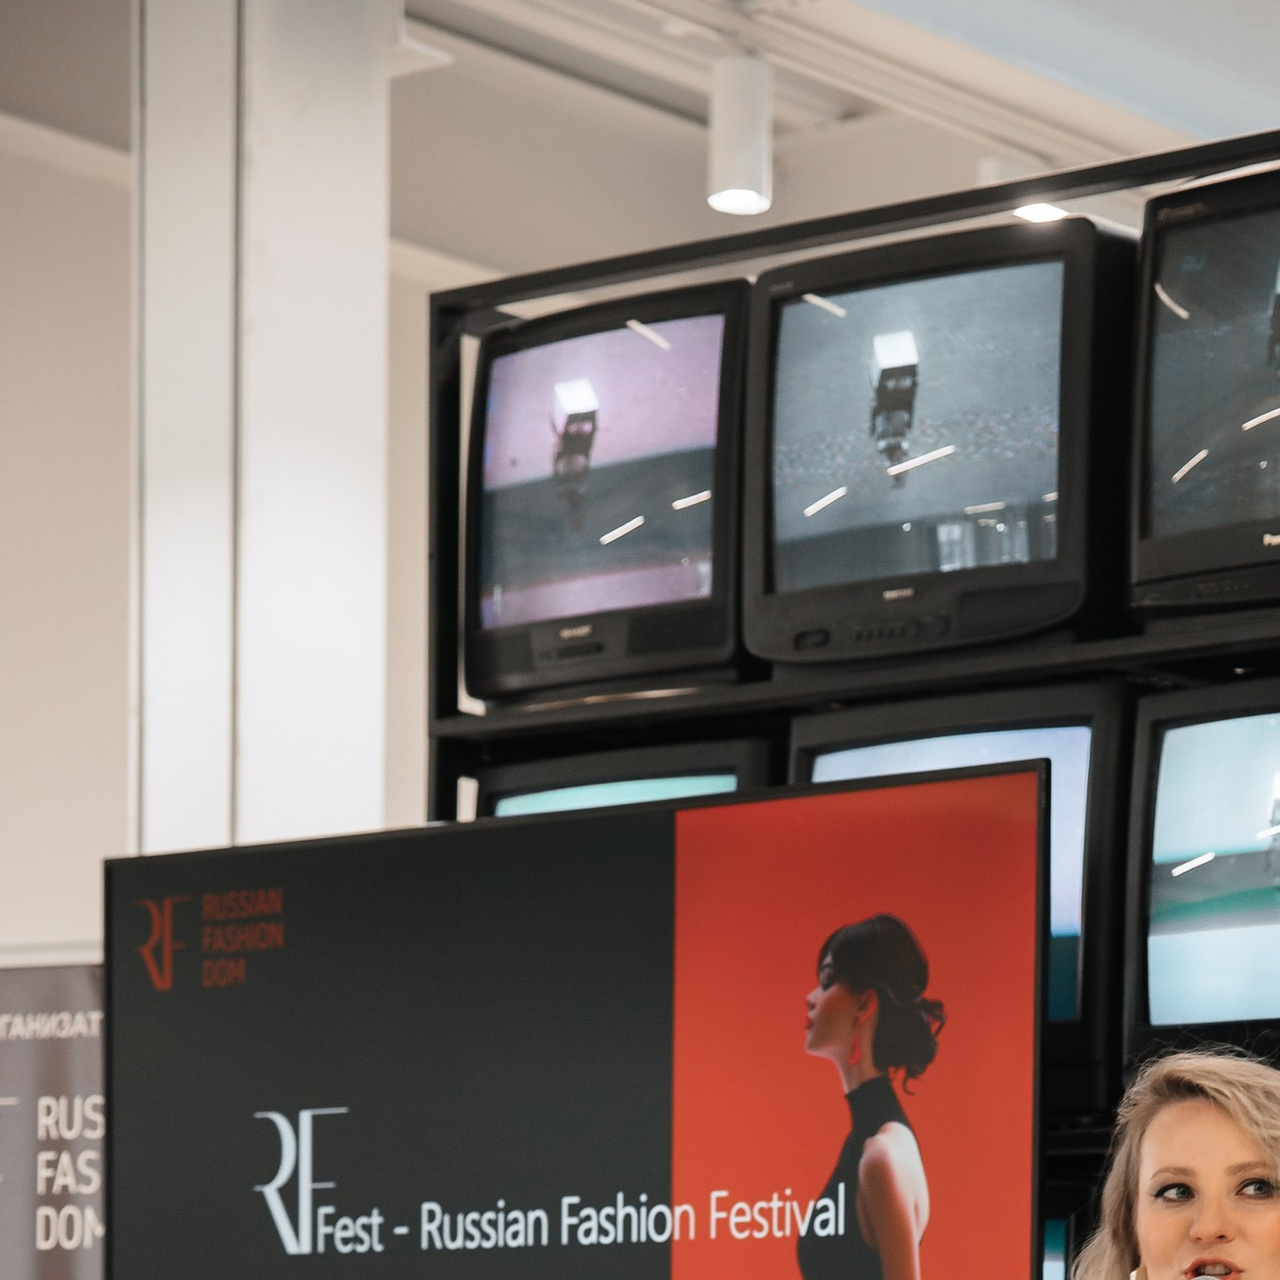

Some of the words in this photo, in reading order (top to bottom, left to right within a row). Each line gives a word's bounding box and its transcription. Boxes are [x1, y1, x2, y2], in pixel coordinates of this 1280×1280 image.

[202, 886, 284, 920] RUSSIAN
[202, 921, 285, 953] FASHION
[202, 957, 246, 988] DOM
[37, 1094, 106, 1141] RUS
[36, 1149, 102, 1196] FAS
[421, 1199, 548, 1250] Russian
[561, 1192, 696, 1245] Fashion
[709, 1183, 845, 1238] Festival
